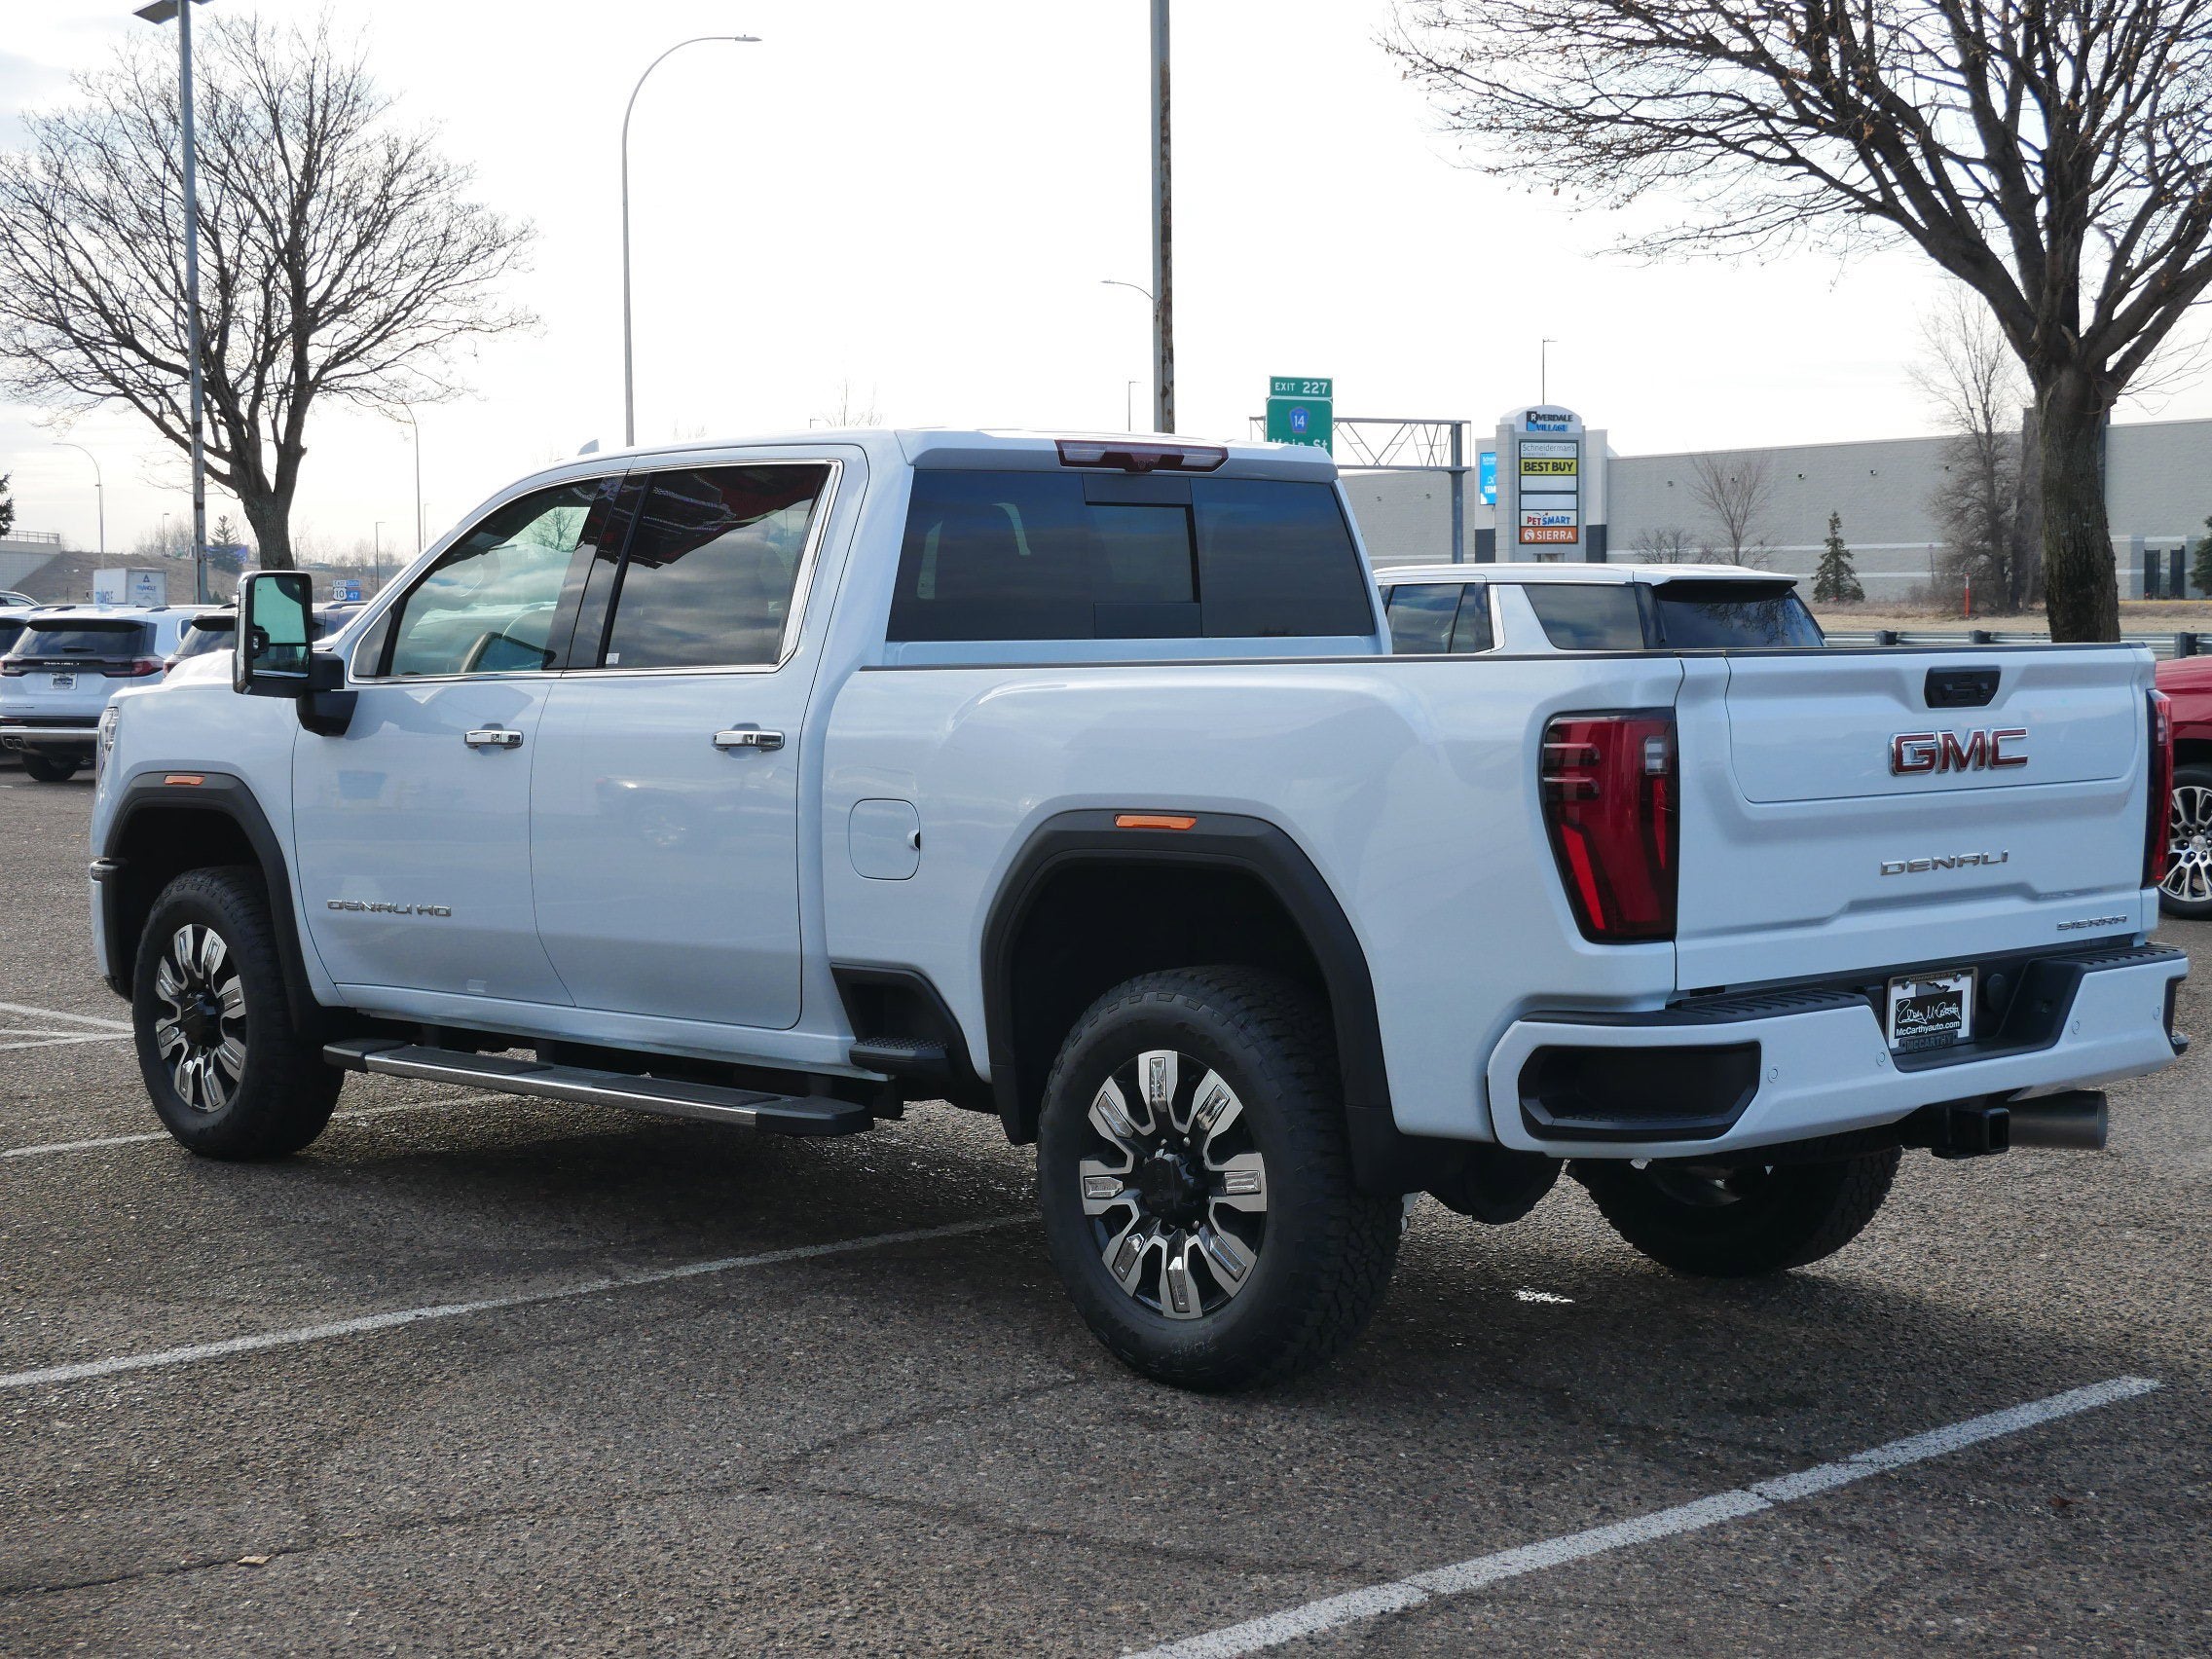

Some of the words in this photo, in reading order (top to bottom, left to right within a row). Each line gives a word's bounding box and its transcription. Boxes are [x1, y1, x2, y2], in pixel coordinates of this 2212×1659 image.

[1274, 382, 1296, 391] EXIT
[1302, 381, 1328, 394] 227
[1294, 415, 1306, 427] 14
[1536, 424, 1568, 432] VILLAGE
[1522, 443, 1575, 452] Schneiderman's
[1524, 461, 1550, 472] BEST
[1551, 461, 1573, 472] BUY
[1536, 530, 1573, 540] SIERRA
[336, 589, 345, 598] 10
[349, 591, 358, 600] 47
[1889, 727, 2028, 776] GMC
[1879, 848, 2009, 876] DENALI
[327, 899, 413, 915] DENALI
[417, 903, 452, 917] HD
[2056, 913, 2128, 931] SIERRA
[1896, 1020, 1960, 1036] McCarthyauto.com
[1907, 1036, 1952, 1051] MCCARTHY
